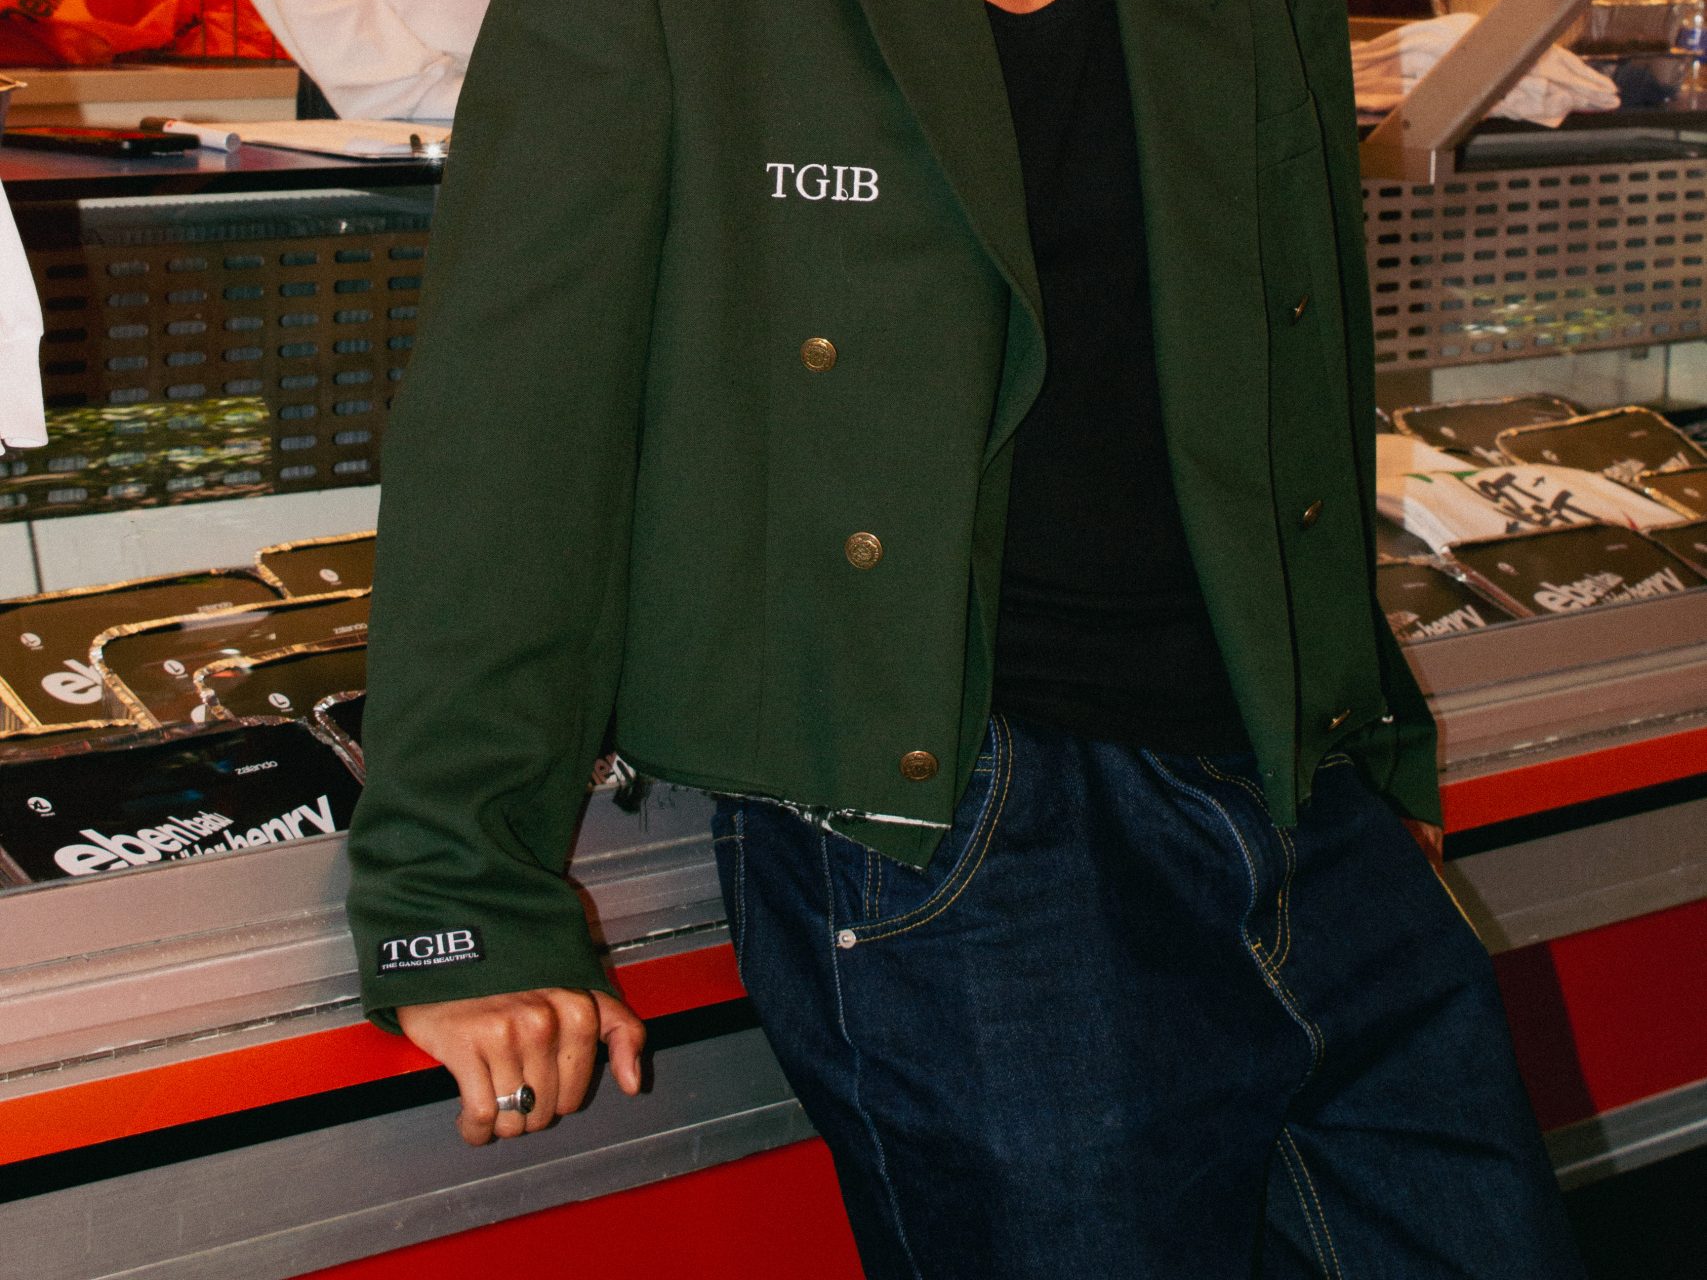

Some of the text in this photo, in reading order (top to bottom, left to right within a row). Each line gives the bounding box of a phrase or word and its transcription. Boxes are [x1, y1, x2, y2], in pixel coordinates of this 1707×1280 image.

[766, 162, 879, 202] TGIB
[234, 760, 278, 775] zalando
[222, 794, 337, 851] henry
[382, 962, 398, 970] THE
[399, 959, 422, 968] GANG
[433, 952, 479, 965] BEAUTIFUL
[383, 929, 476, 961] TGIB
